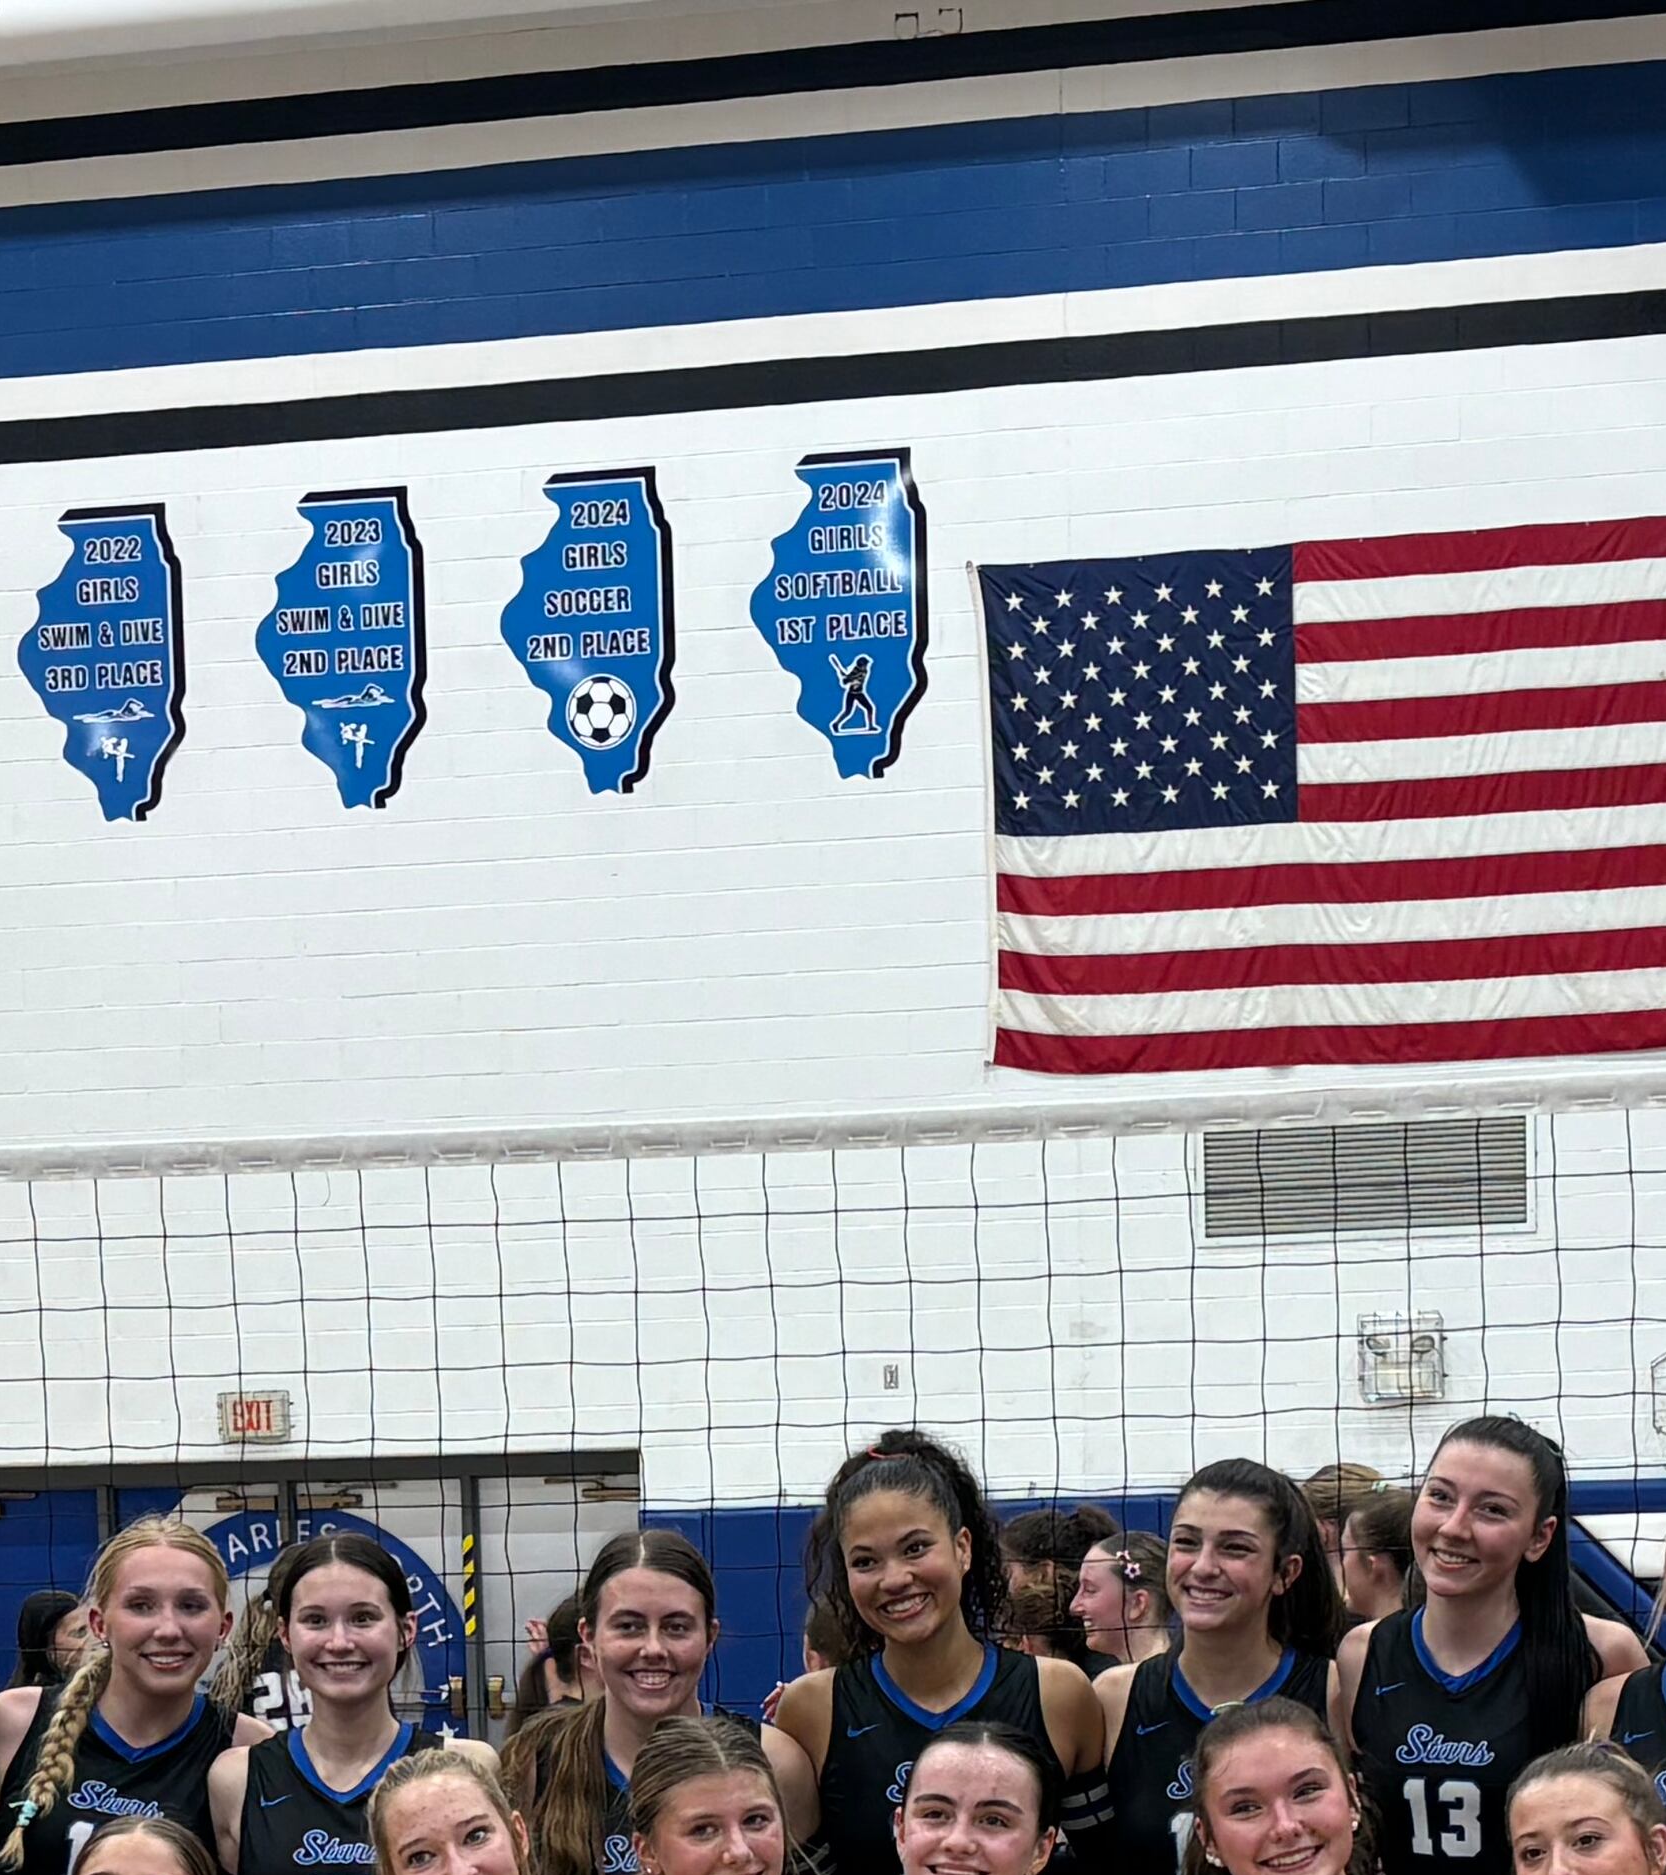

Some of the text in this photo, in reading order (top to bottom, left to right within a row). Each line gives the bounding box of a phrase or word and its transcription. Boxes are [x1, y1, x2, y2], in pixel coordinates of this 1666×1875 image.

[818, 480, 886, 511] 2024
[571, 499, 630, 528] 2024
[325, 518, 382, 547] 2023
[808, 523, 884, 554] GIRLS
[84, 535, 141, 564] 2022
[563, 541, 627, 571] GIRLS
[316, 558, 379, 587] GIRLS
[775, 568, 903, 601] SOFTBALL
[77, 576, 138, 605] GIRLS
[545, 586, 631, 617] SOCCER
[276, 602, 404, 635] SWIM & DIVE
[776, 610, 907, 644] 1ST PLACE
[38, 618, 163, 651] SWIM & DIVE
[527, 628, 650, 661] 2ND PLACE
[45, 660, 163, 692] 3RD PLACE
[284, 645, 403, 676] 2ND PLACE
[232, 1399, 275, 1433] EXIT
[1396, 1723, 1495, 1767] Stars
[1403, 1777, 1483, 1858] 13
